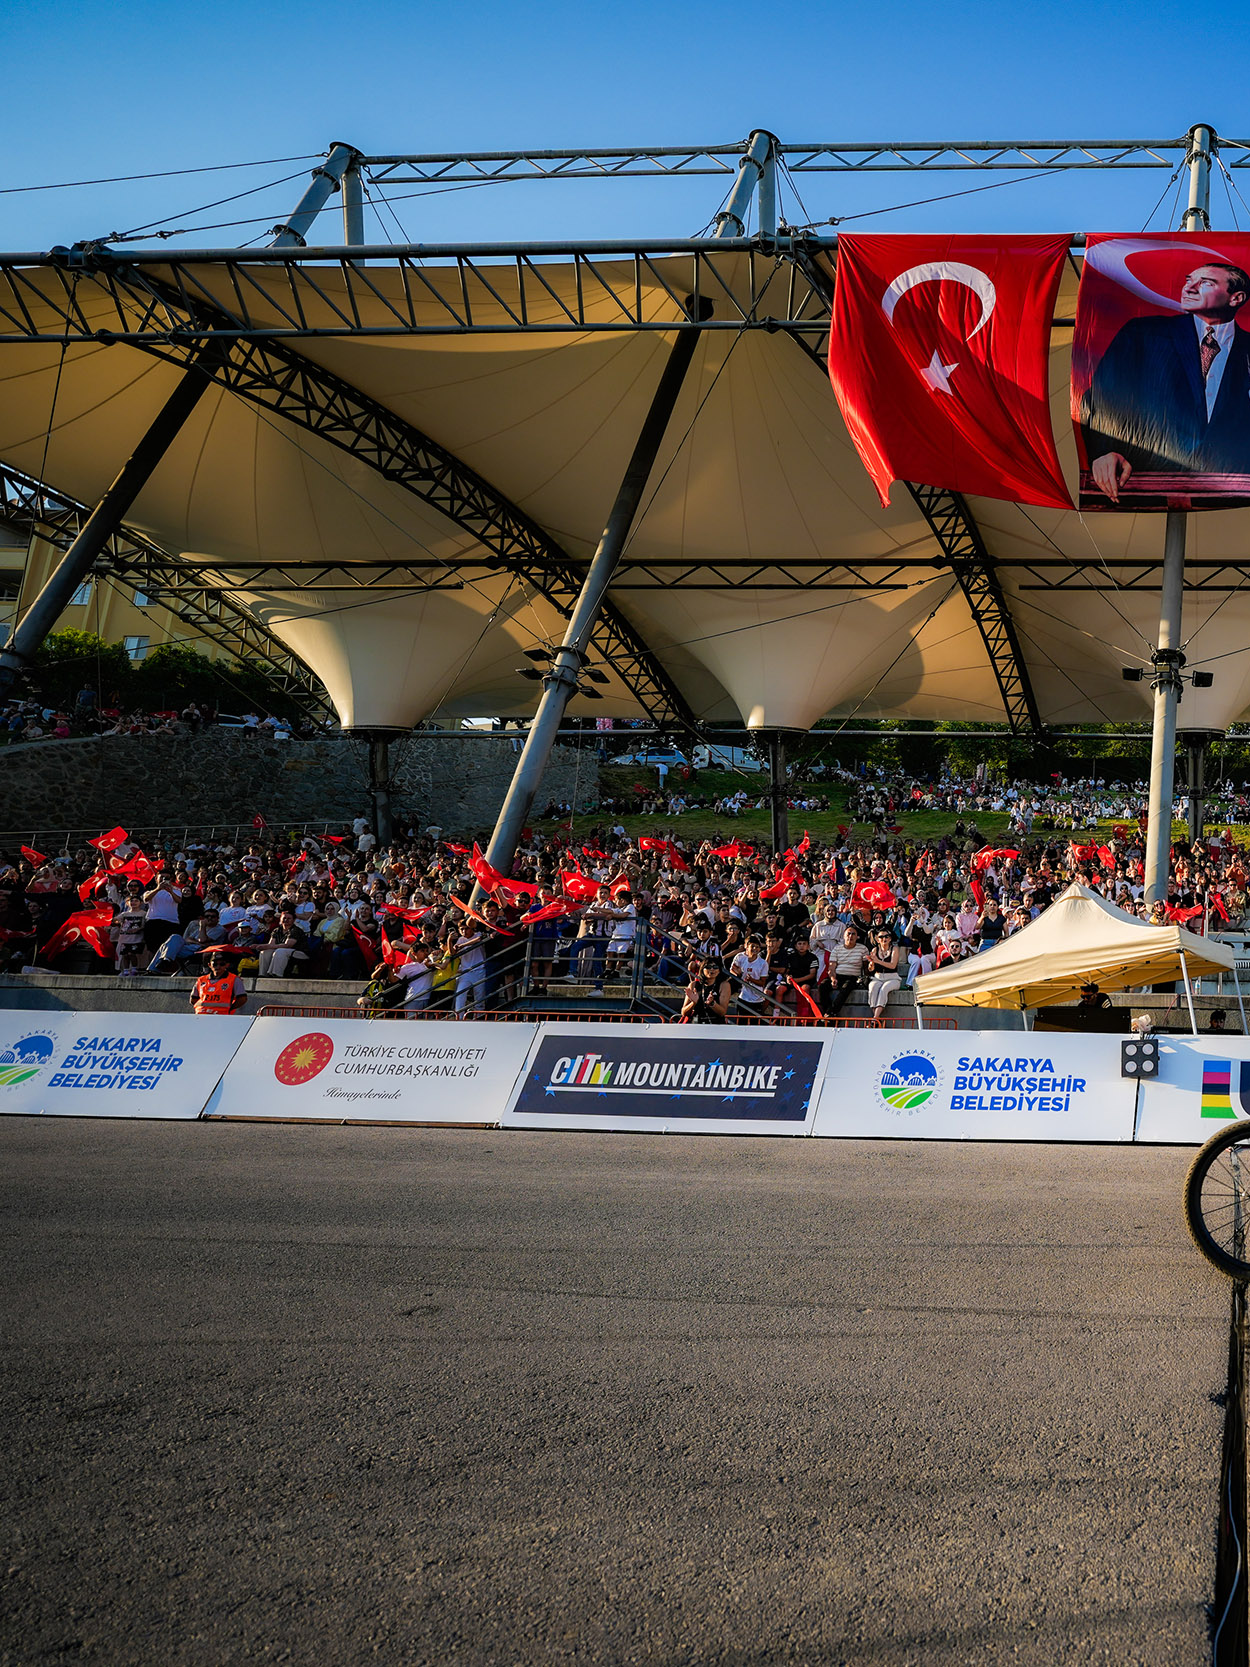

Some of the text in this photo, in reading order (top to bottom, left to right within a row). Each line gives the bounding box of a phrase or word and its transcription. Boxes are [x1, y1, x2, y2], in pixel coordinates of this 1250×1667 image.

[72, 1036, 162, 1053] SAKARYA
[344, 1044, 487, 1060] TÜRKİYE CUMHURİYETİ
[60, 1052, 184, 1073] BÜYÜKŞEHİR
[892, 1049, 936, 1060] SAKARYA
[334, 1062, 480, 1079] CUMHURBAŞKANLIĞI
[956, 1057, 1055, 1073] SAKARYA
[48, 1071, 162, 1090] BELEDİYESİ
[613, 1062, 782, 1090] MOUNTAINBIKE
[953, 1073, 1087, 1094] BÜYÜKŞEHİR
[322, 1086, 402, 1102] Himayelerinde
[950, 1093, 1070, 1112] BELEDİYESİ
